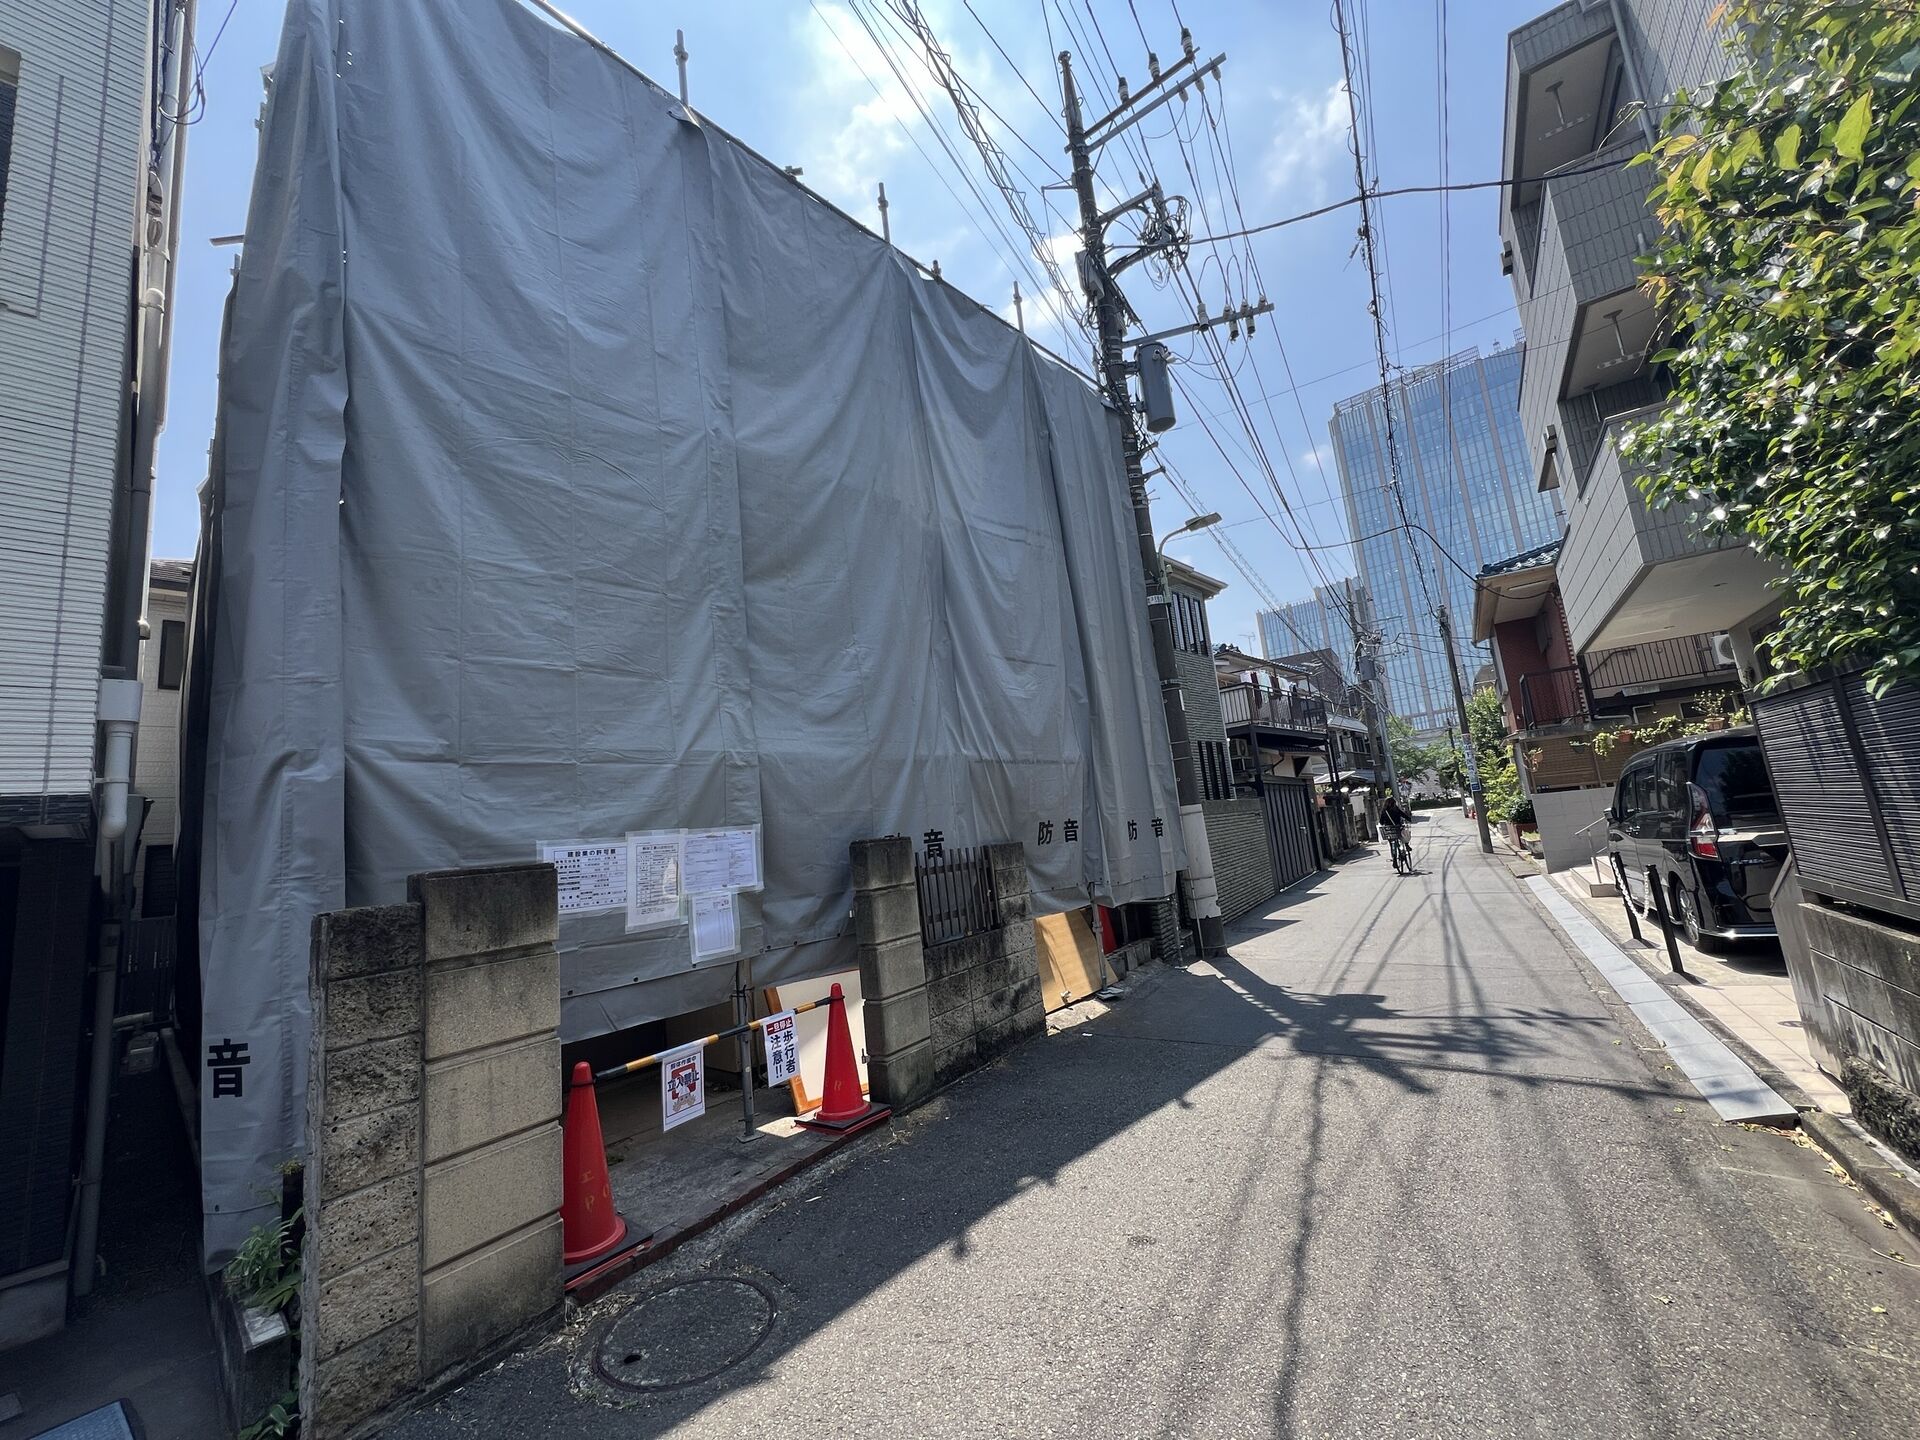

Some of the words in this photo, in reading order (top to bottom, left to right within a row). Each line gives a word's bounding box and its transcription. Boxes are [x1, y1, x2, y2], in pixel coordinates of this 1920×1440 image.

[1038, 818, 1079, 846] 防音
[1127, 817, 1164, 841] 防音
[783, 1030, 796, 1074] 歩行者
[207, 1038, 251, 1099] 音
[667, 1069, 700, 1093] 立入禁止
